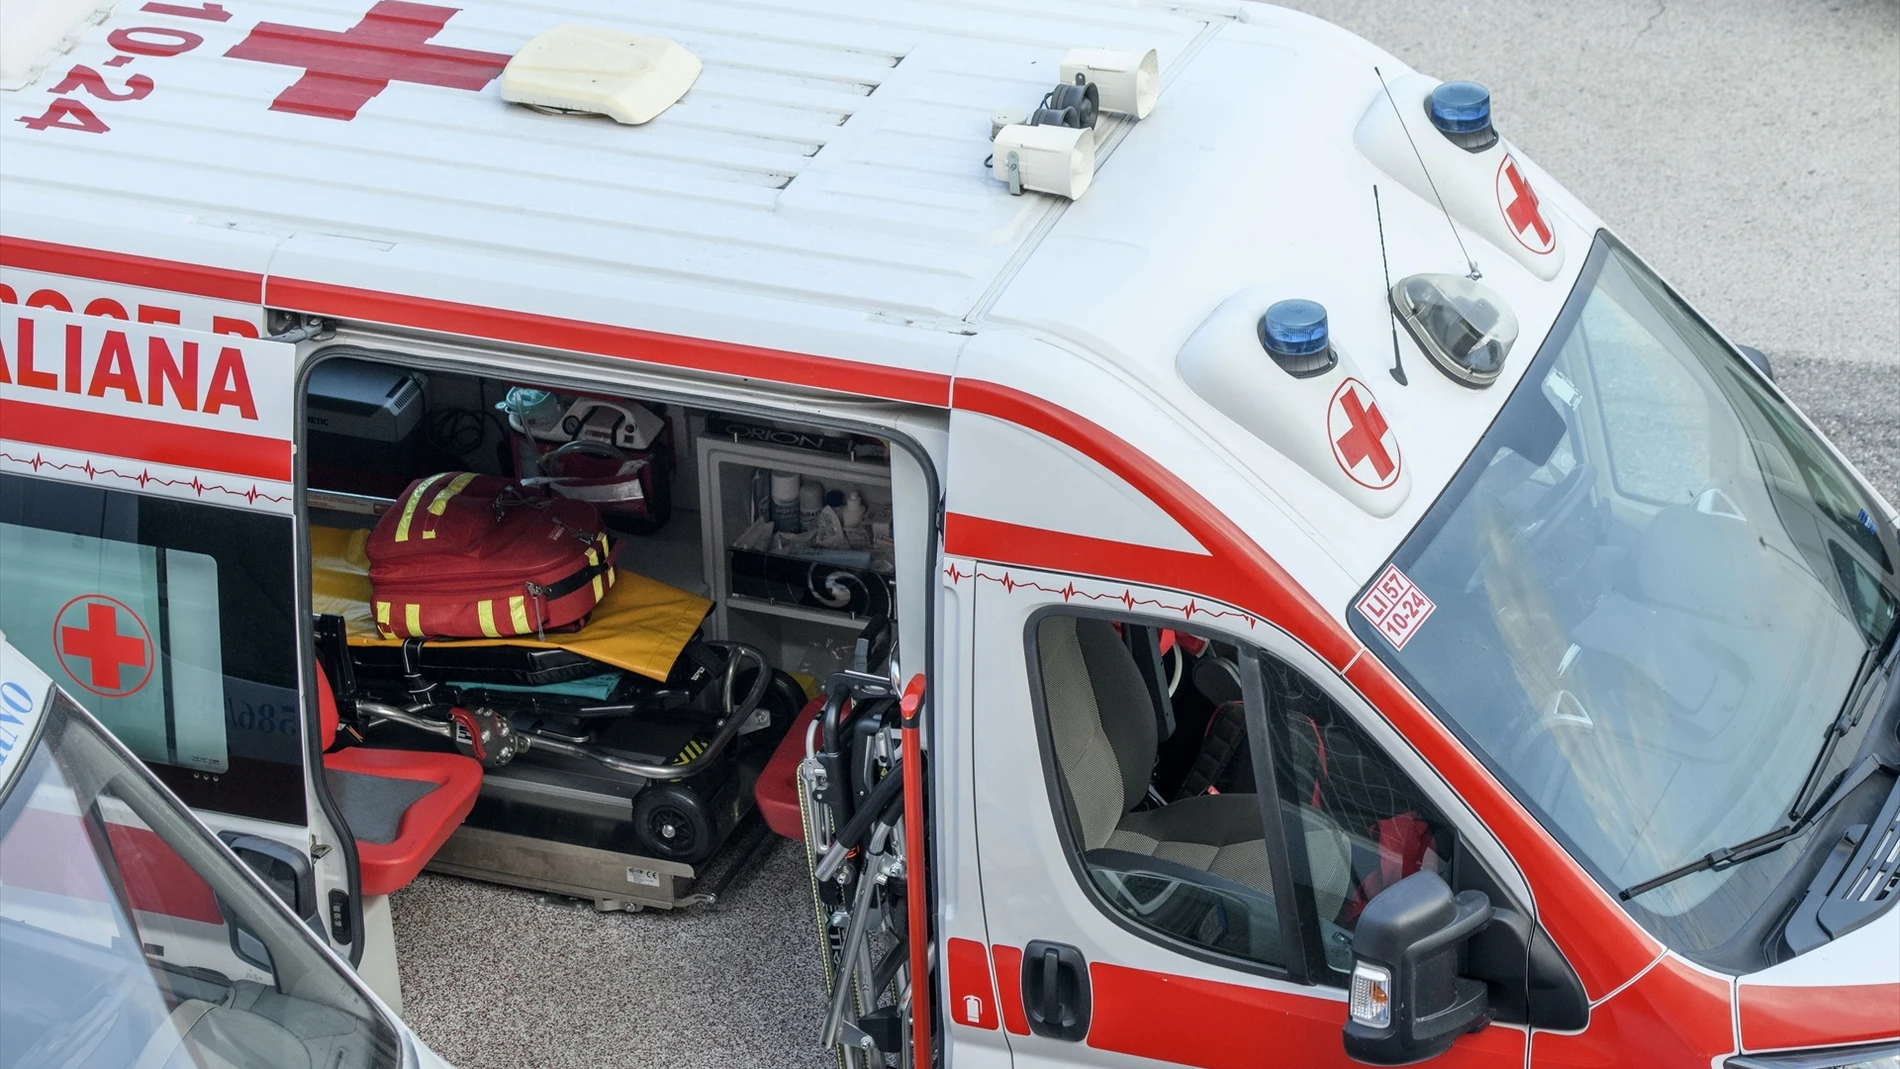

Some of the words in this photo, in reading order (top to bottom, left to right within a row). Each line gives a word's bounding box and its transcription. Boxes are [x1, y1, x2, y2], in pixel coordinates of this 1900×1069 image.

[14, 2, 233, 134] 10-24
[0, 317, 258, 421] LIANA
[725, 425, 824, 449] ORION
[1366, 594, 1388, 618] LI
[1382, 573, 1404, 599] 57
[1386, 591, 1425, 637] 10-24
[0, 682, 33, 766] NO
